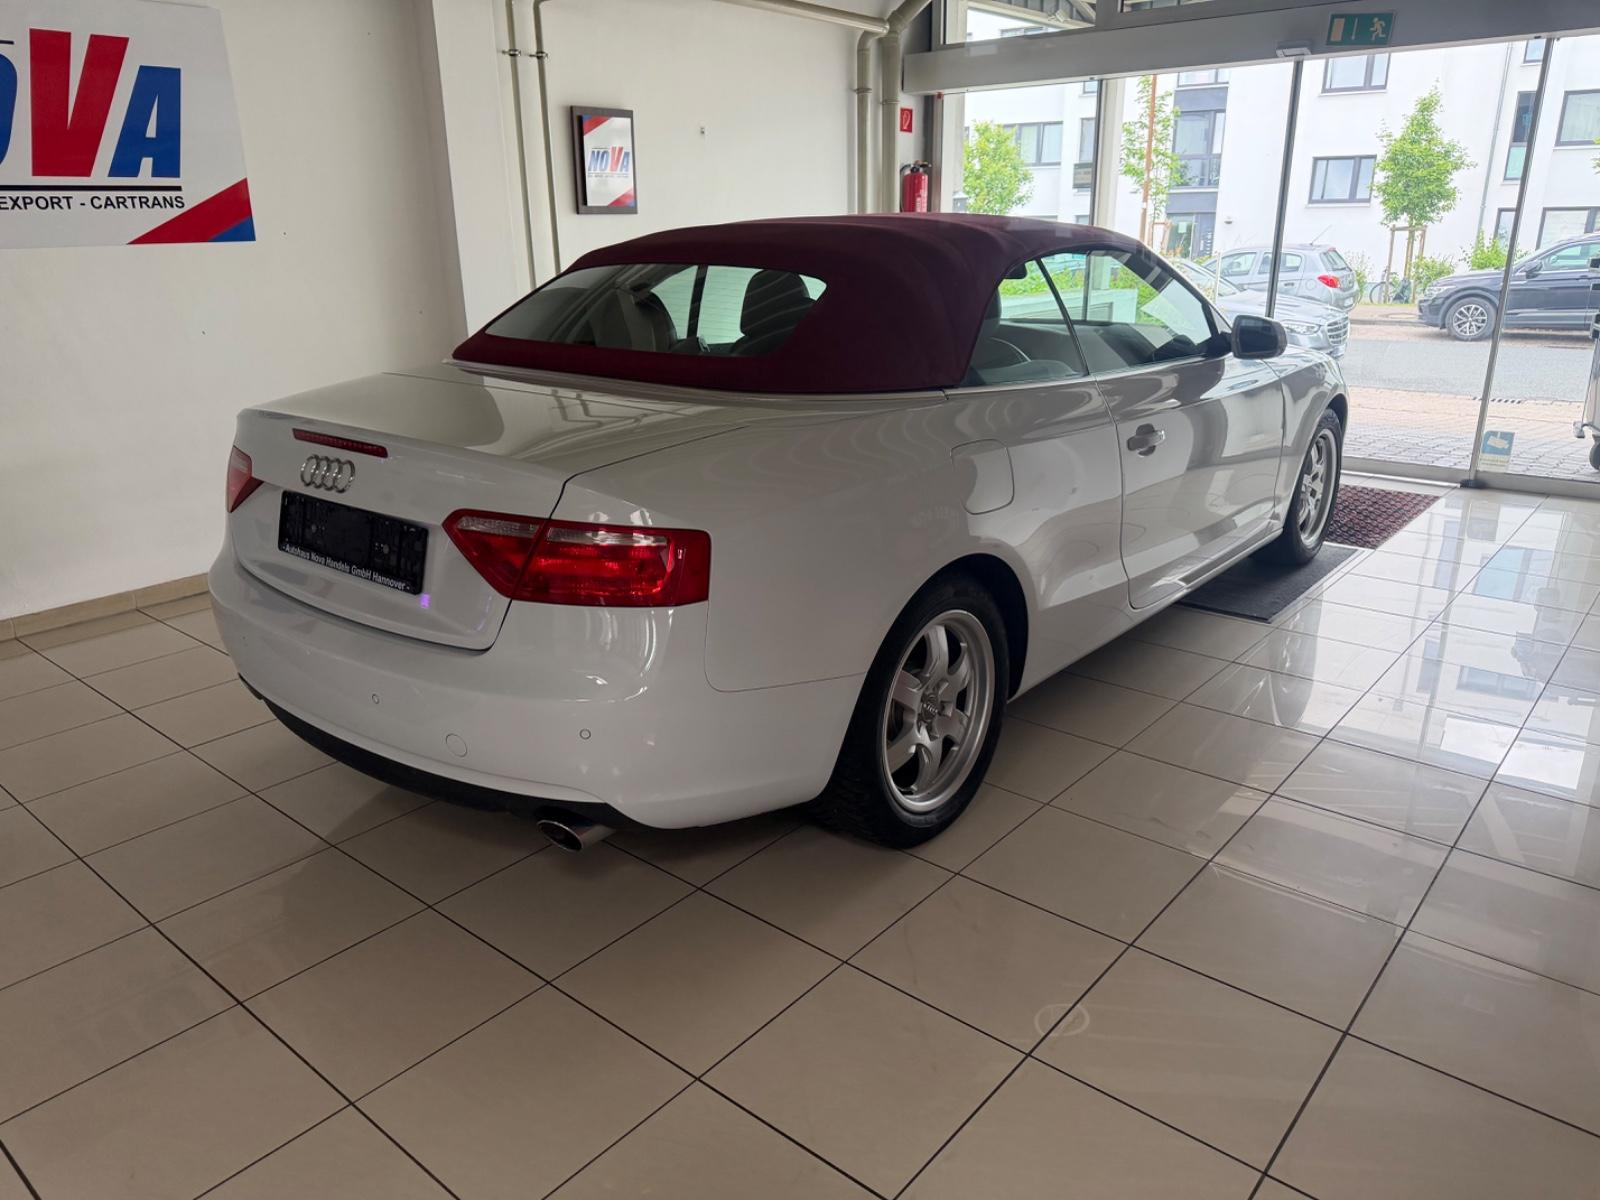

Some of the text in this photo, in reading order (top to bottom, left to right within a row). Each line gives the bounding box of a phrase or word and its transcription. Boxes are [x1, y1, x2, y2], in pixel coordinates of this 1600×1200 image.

[588, 147, 630, 172] NOVA
[0, 196, 73, 210] EXPORT
[91, 196, 185, 209] CARTRANS
[285, 544, 310, 559] Autohaus
[310, 552, 325, 565] Nova
[326, 557, 350, 572] Handels
[351, 565, 372, 580] GmbH
[372, 571, 405, 590] Hannover
